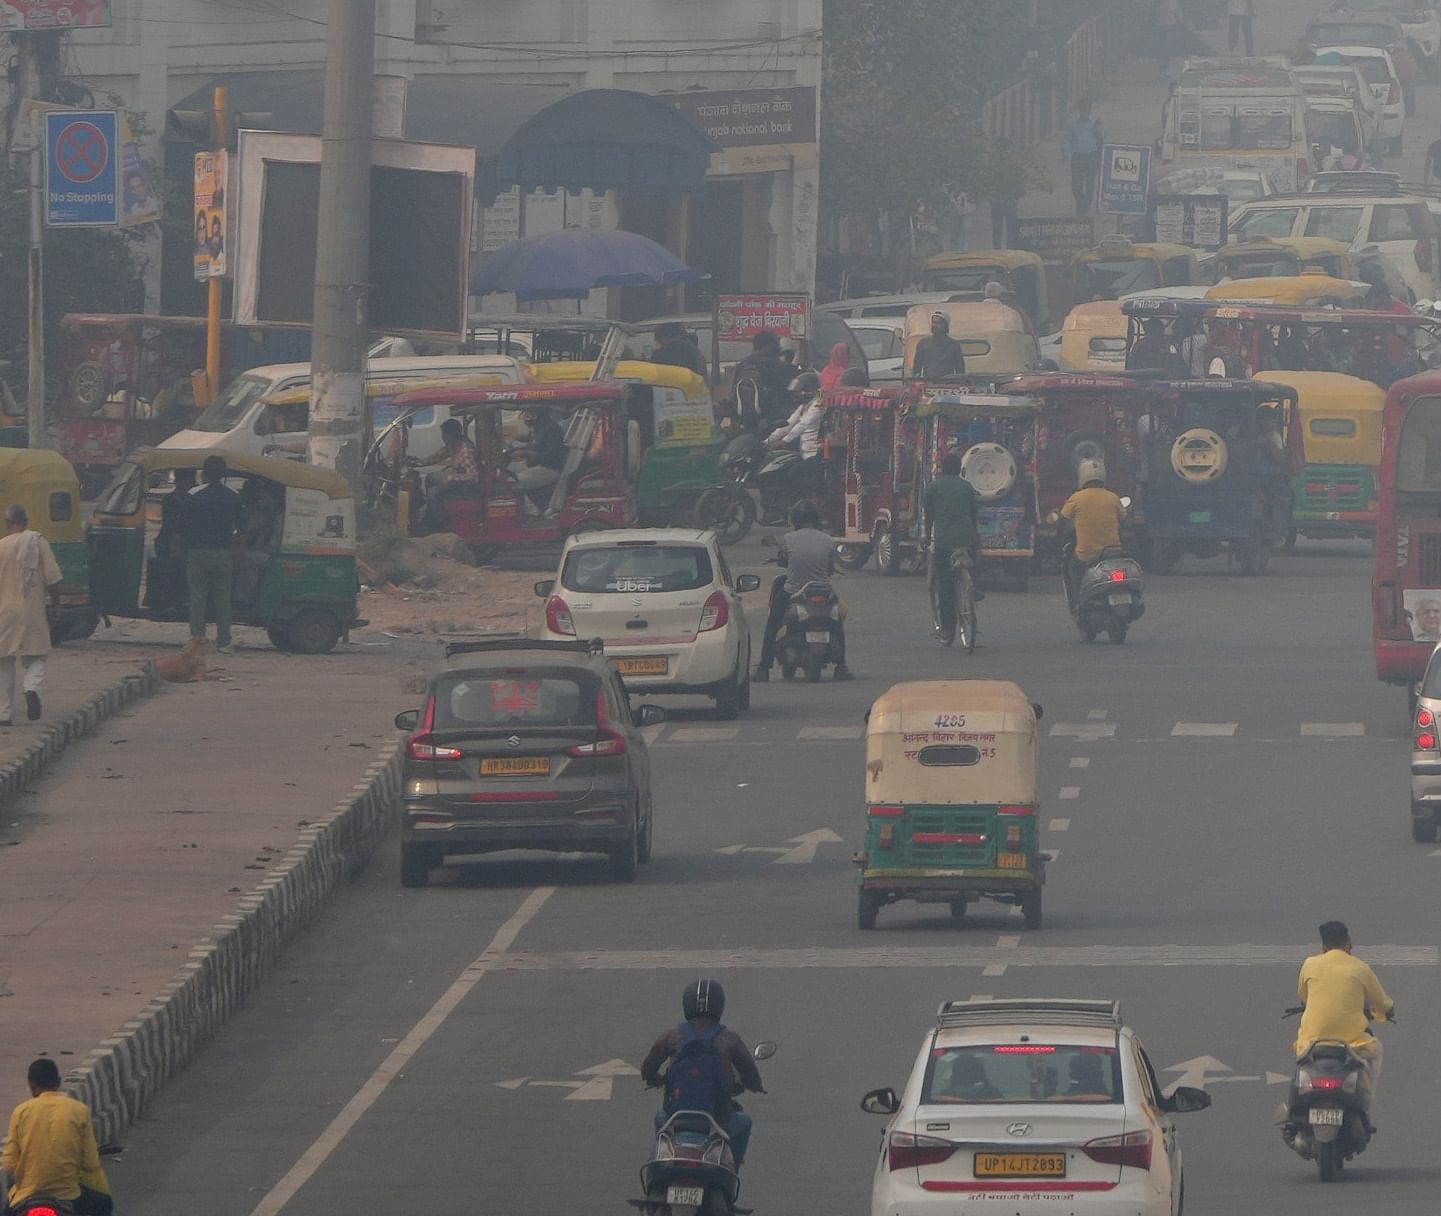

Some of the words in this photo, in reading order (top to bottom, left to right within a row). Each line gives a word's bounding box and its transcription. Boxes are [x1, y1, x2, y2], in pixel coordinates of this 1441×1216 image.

[731, 121, 768, 135] national
[771, 120, 793, 133] bank
[50, 193, 66, 202] No
[67, 192, 114, 204] Stopping
[1395, 525, 1409, 568] TATA
[616, 580, 651, 592] Uber
[984, 1158, 1064, 1172] UP14JT2893
